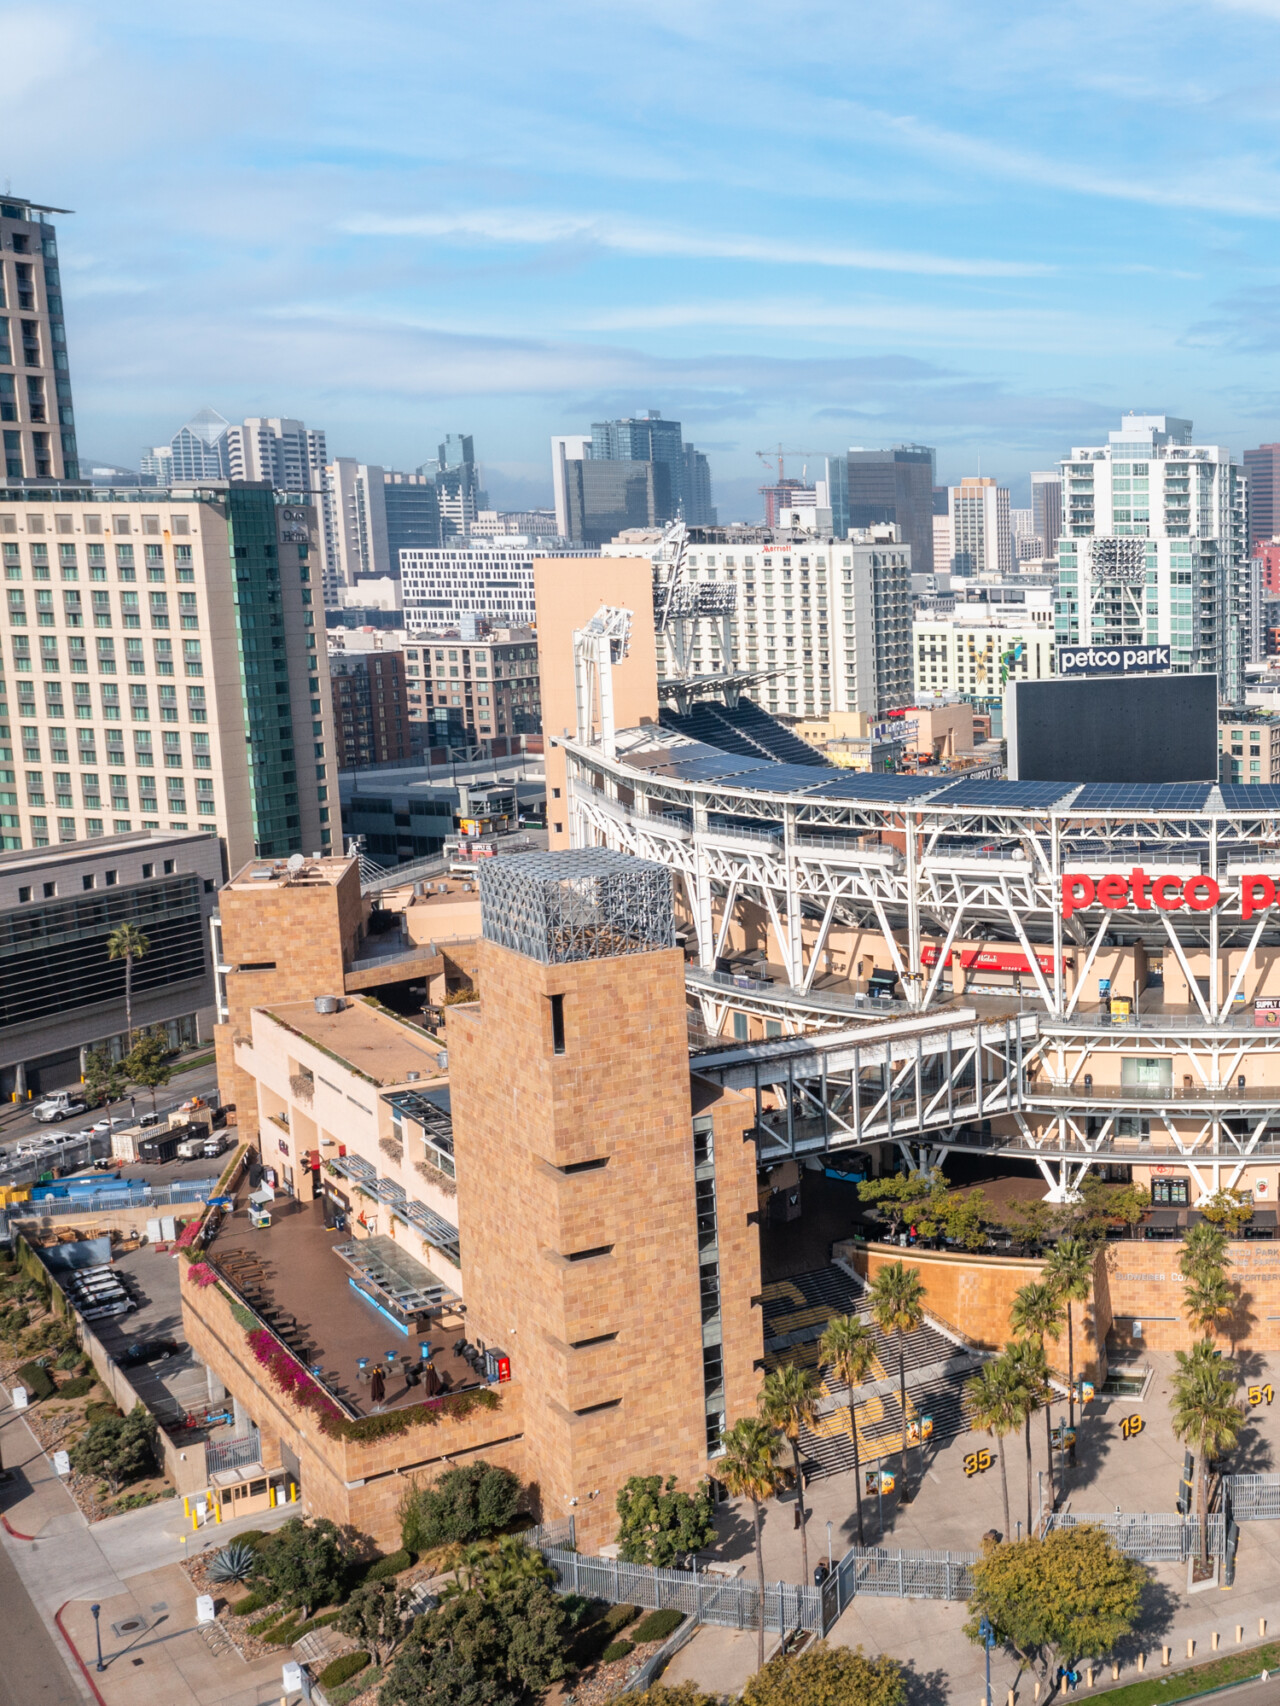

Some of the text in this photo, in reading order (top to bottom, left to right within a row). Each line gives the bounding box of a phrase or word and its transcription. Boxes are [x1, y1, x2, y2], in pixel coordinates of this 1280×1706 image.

[762, 545, 791, 553] Marriott
[1062, 648, 1169, 672] petco park
[1062, 867, 1220, 919] petco
[1256, 1001, 1277, 1009] SUPPLY
[1249, 1385, 1273, 1405] 51
[1120, 1414, 1142, 1438] 19
[964, 1450, 991, 1475] 35
